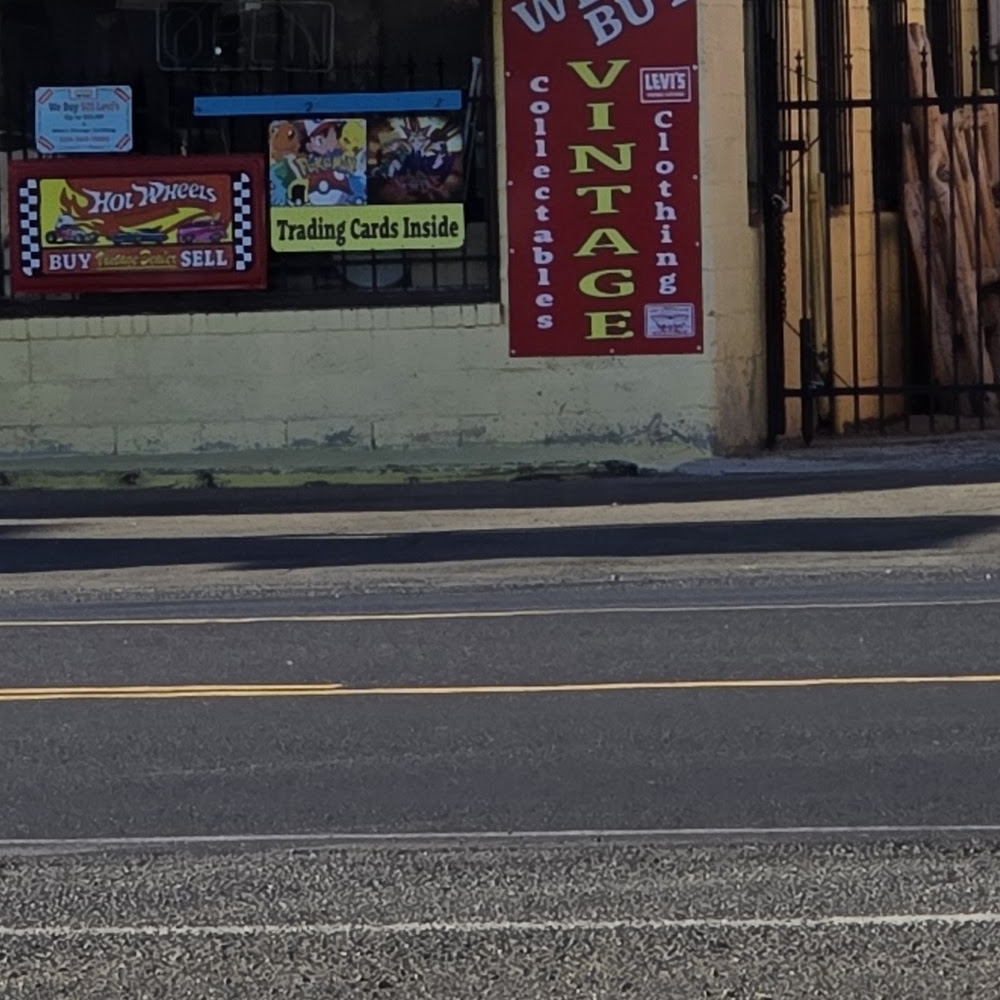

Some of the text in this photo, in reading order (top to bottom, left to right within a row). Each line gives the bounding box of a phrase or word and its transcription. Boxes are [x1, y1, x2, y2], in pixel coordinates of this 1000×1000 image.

[644, 72, 686, 90] LEVI'S
[566, 59, 640, 340] VINTAGE
[277, 214, 459, 246] Trading Cards Inside
[49, 254, 92, 270] BUY
[180, 250, 228, 267] SELL
